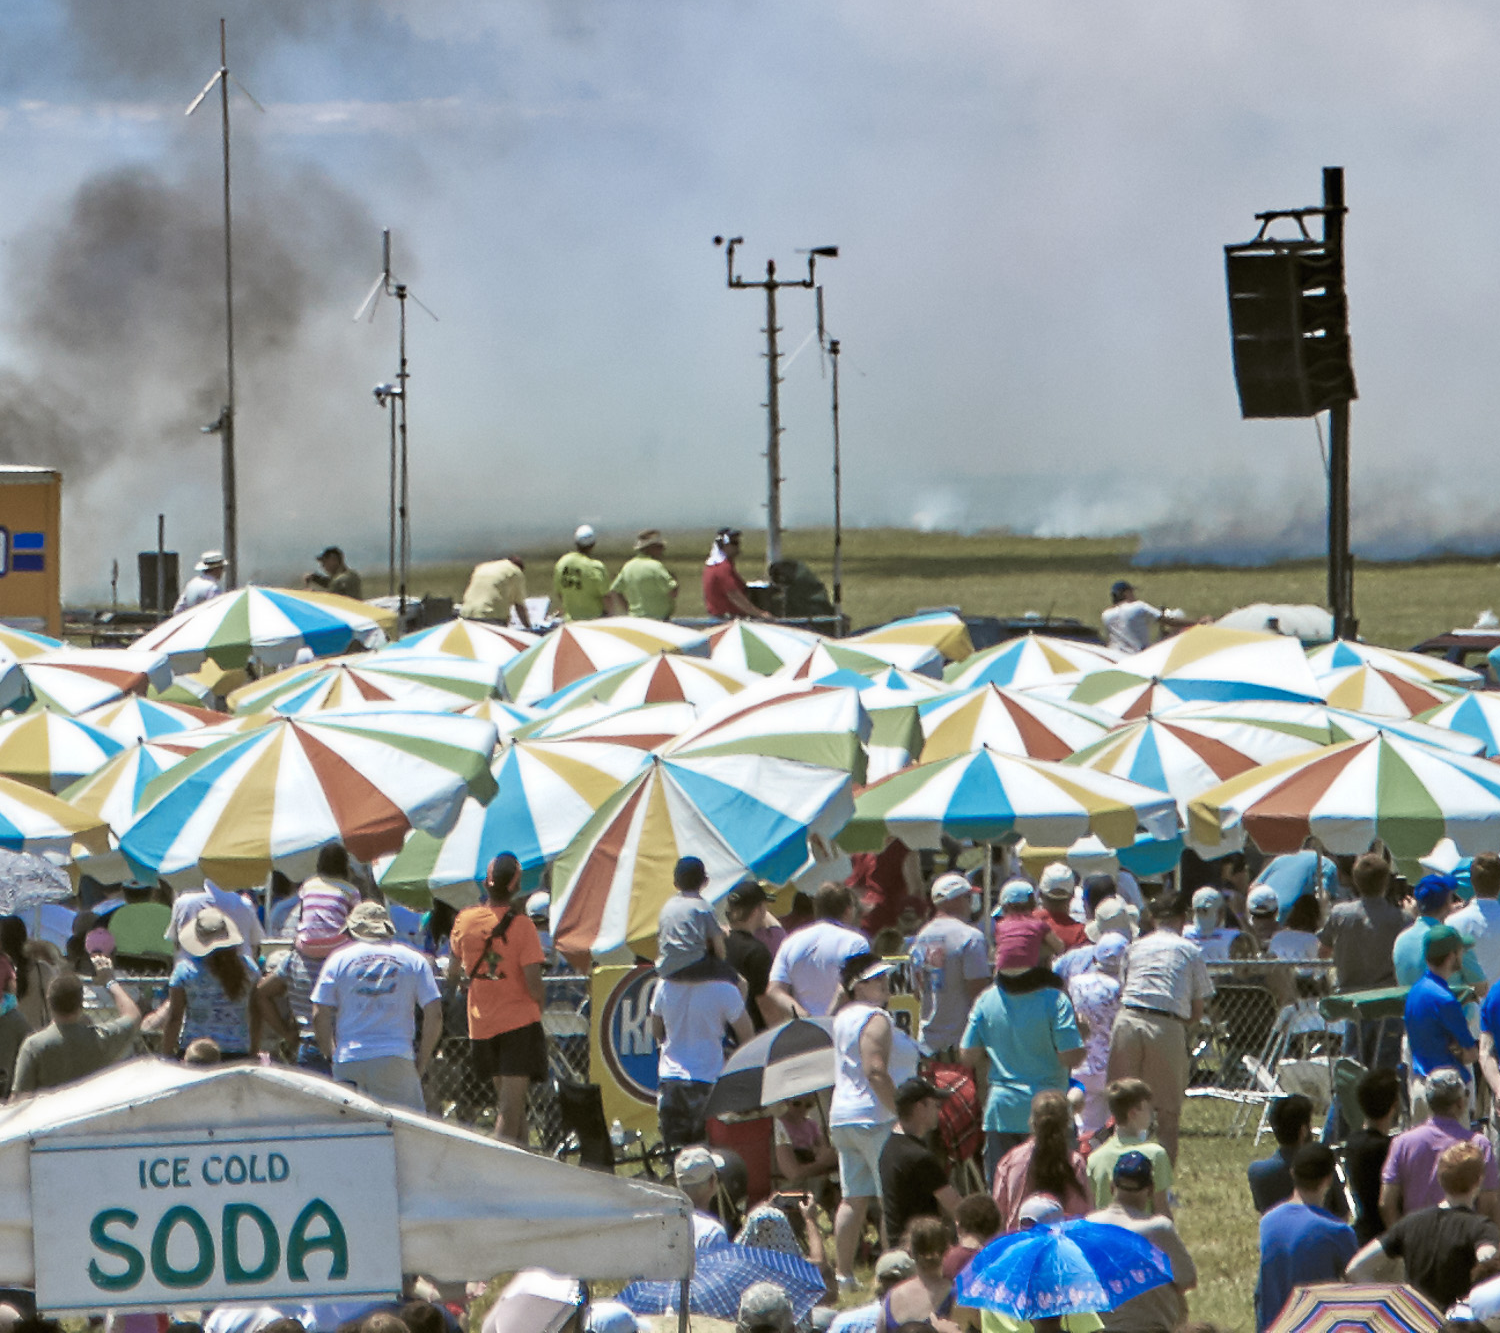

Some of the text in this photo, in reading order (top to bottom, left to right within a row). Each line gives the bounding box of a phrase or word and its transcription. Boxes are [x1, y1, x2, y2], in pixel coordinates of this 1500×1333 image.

[138, 1152, 290, 1189] ICE COLD
[87, 1197, 349, 1292] SODA
